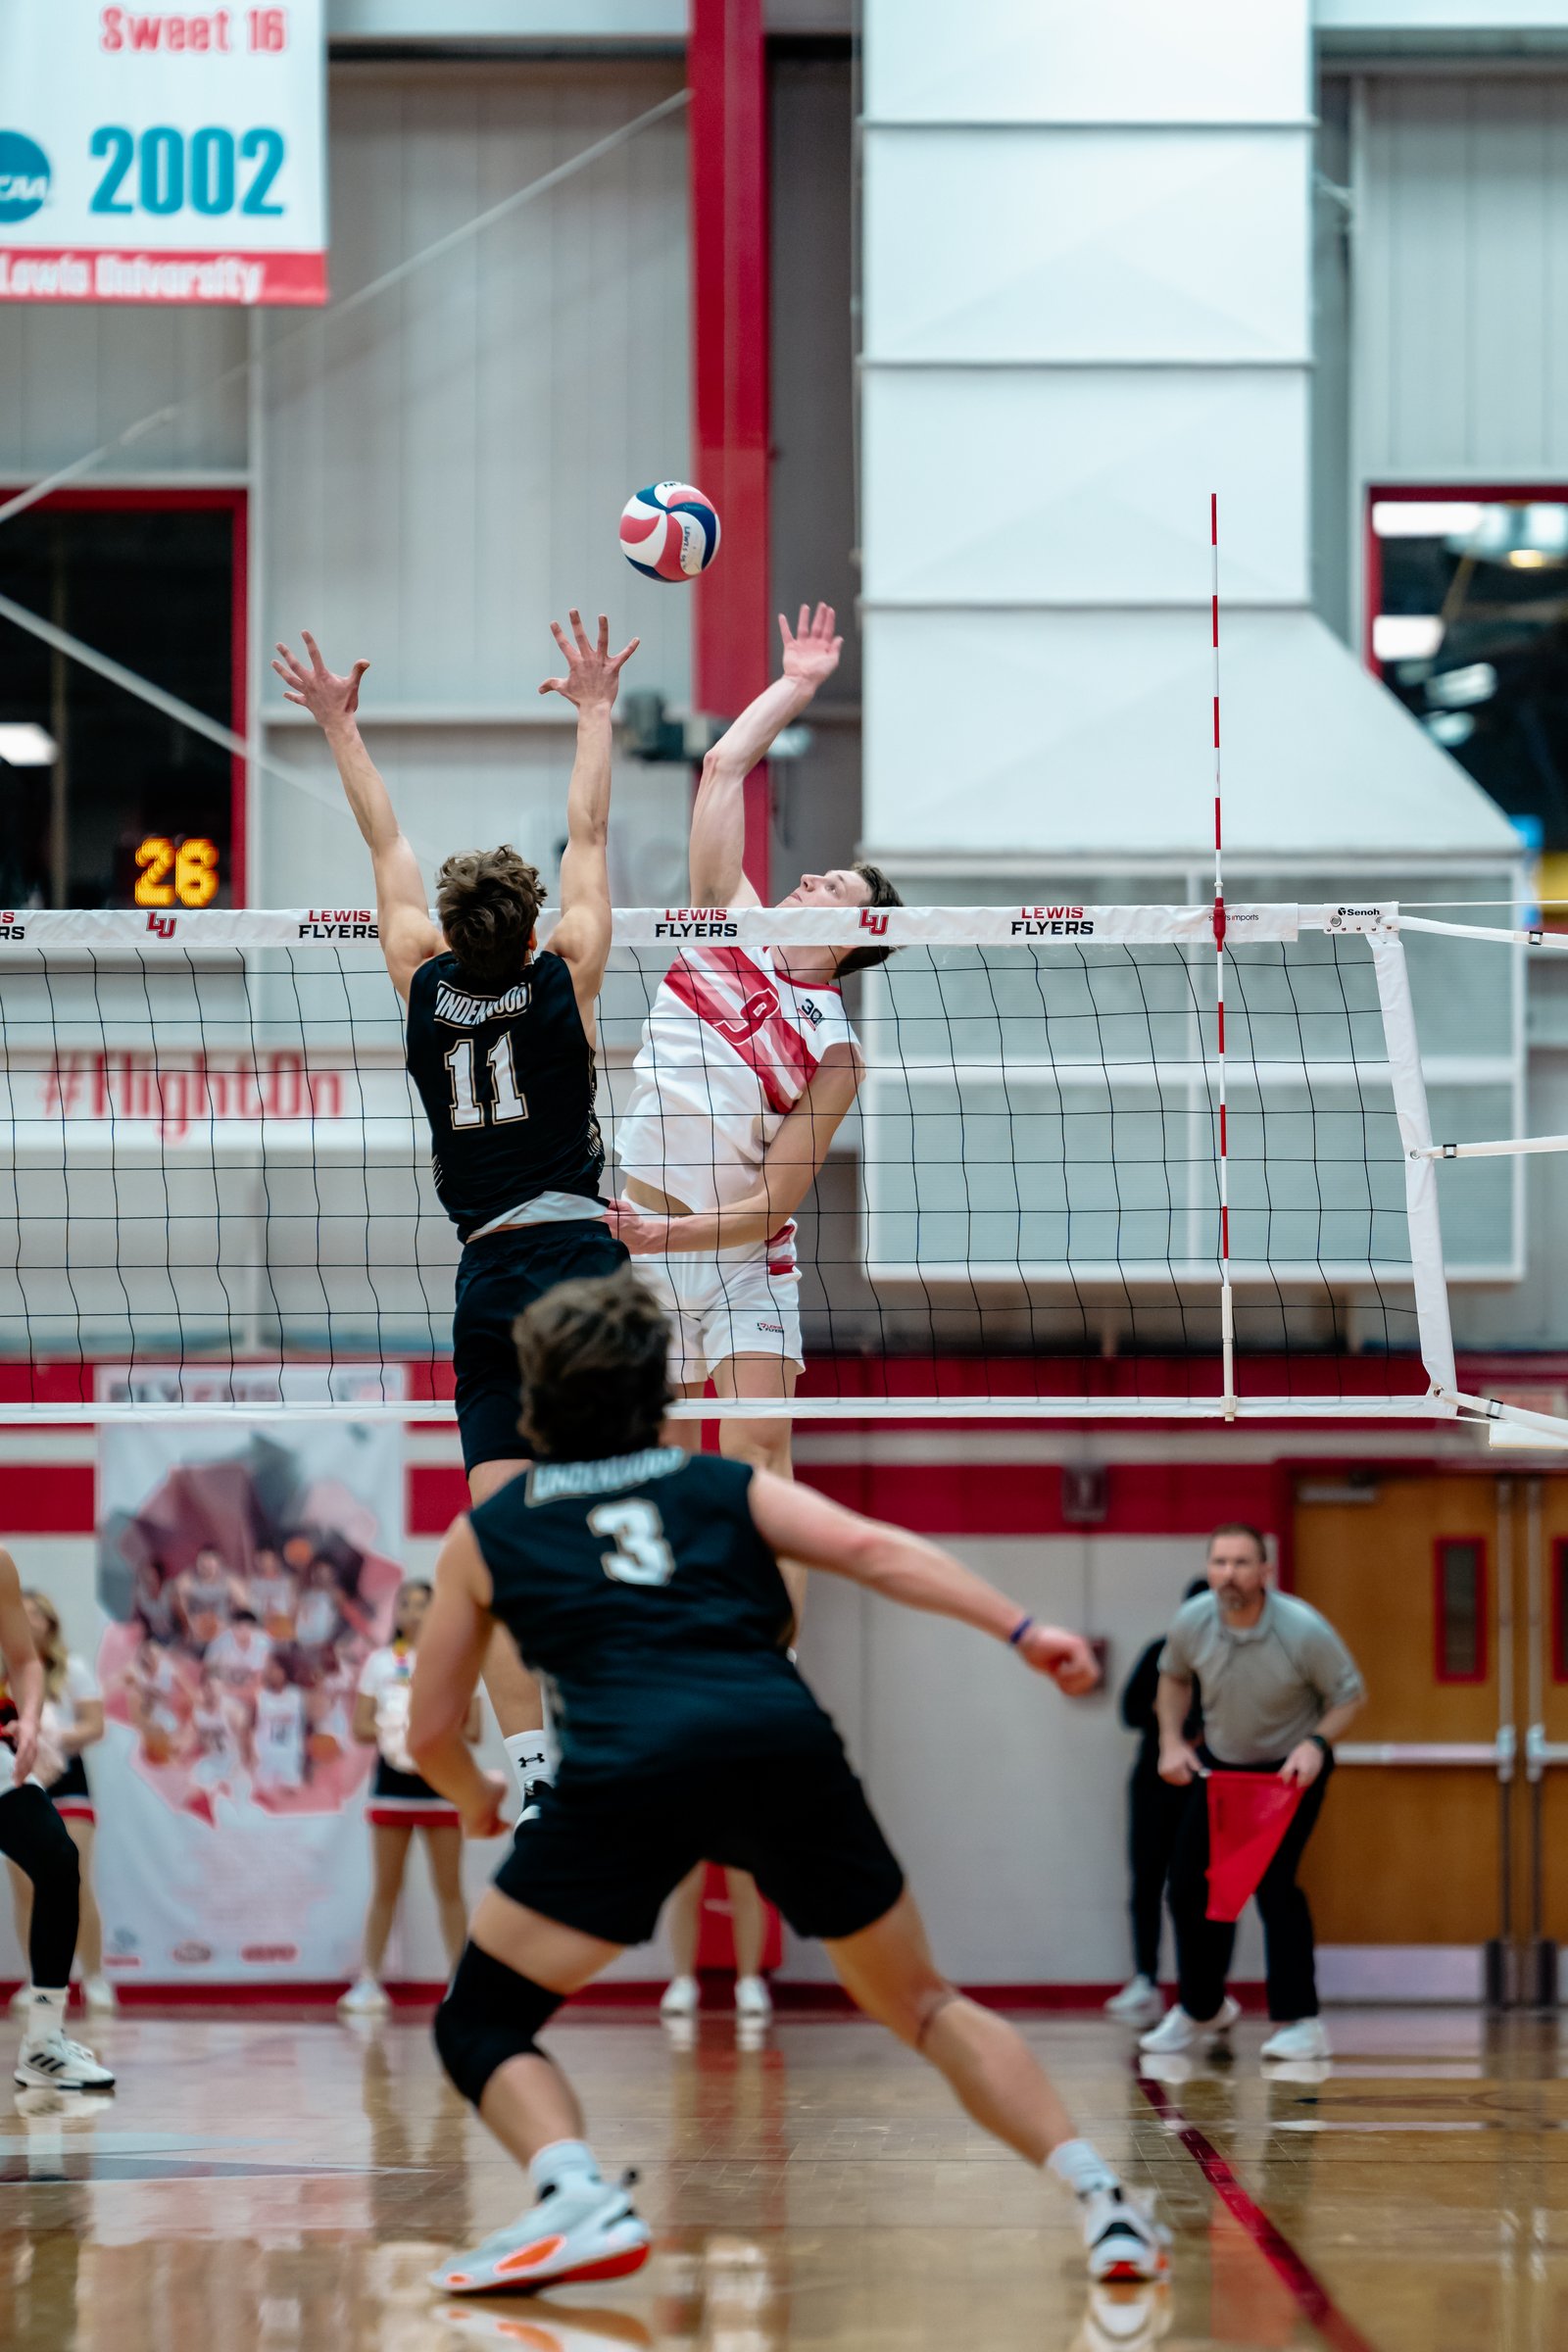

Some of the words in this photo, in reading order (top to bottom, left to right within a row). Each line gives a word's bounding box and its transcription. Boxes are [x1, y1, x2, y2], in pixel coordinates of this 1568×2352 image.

[101, 6, 230, 52] Sweet
[248, 8, 286, 53] 16
[90, 125, 284, 215] 2002
[0, 174, 47, 201] CAA
[96, 254, 265, 303] University
[134, 838, 220, 907] 26
[146, 911, 177, 940] LU
[309, 910, 371, 922] LEWIS
[665, 909, 727, 921] LEWIS
[858, 908, 889, 936] LU
[1021, 906, 1084, 919] LEWIS
[298, 925, 379, 939] FLYERS
[655, 923, 738, 938] FLYERS
[1010, 921, 1095, 935] FLYERS
[444, 1031, 529, 1130] 11
[41, 1051, 343, 1145] #FlightOn
[586, 1496, 675, 1586] 3
